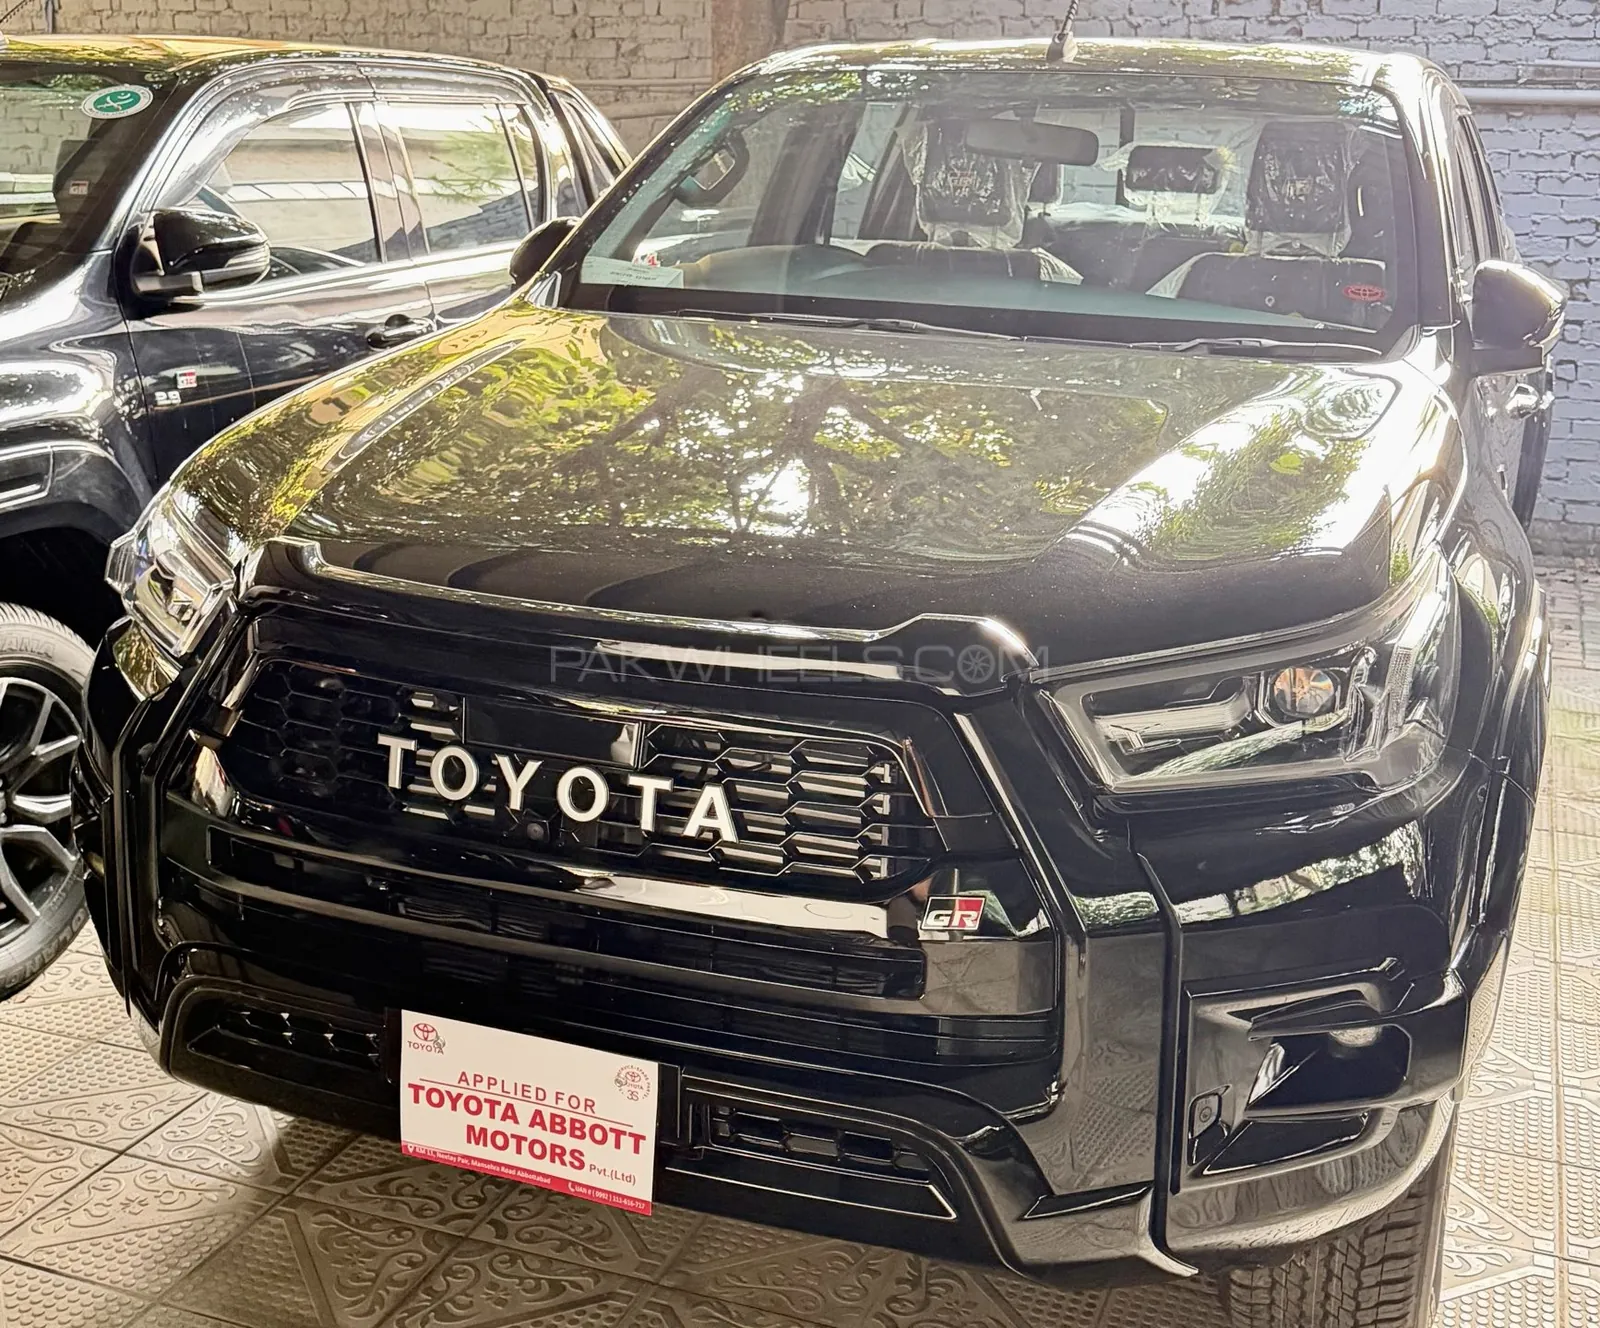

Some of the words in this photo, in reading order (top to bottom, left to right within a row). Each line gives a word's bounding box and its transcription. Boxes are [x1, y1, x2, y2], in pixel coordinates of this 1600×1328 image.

[377, 733, 739, 844] TOYOTA
[926, 909, 978, 927] GR
[407, 1040, 444, 1056] TOYOTA
[457, 1071, 547, 1101] APPLIED
[555, 1091, 596, 1114] FOR
[627, 1089, 639, 1102] 3S
[408, 1083, 520, 1124] TOYOTA
[528, 1109, 647, 1154] ABBOTT
[466, 1124, 586, 1171] MOTORS
[500, 1166, 516, 1175] Road
